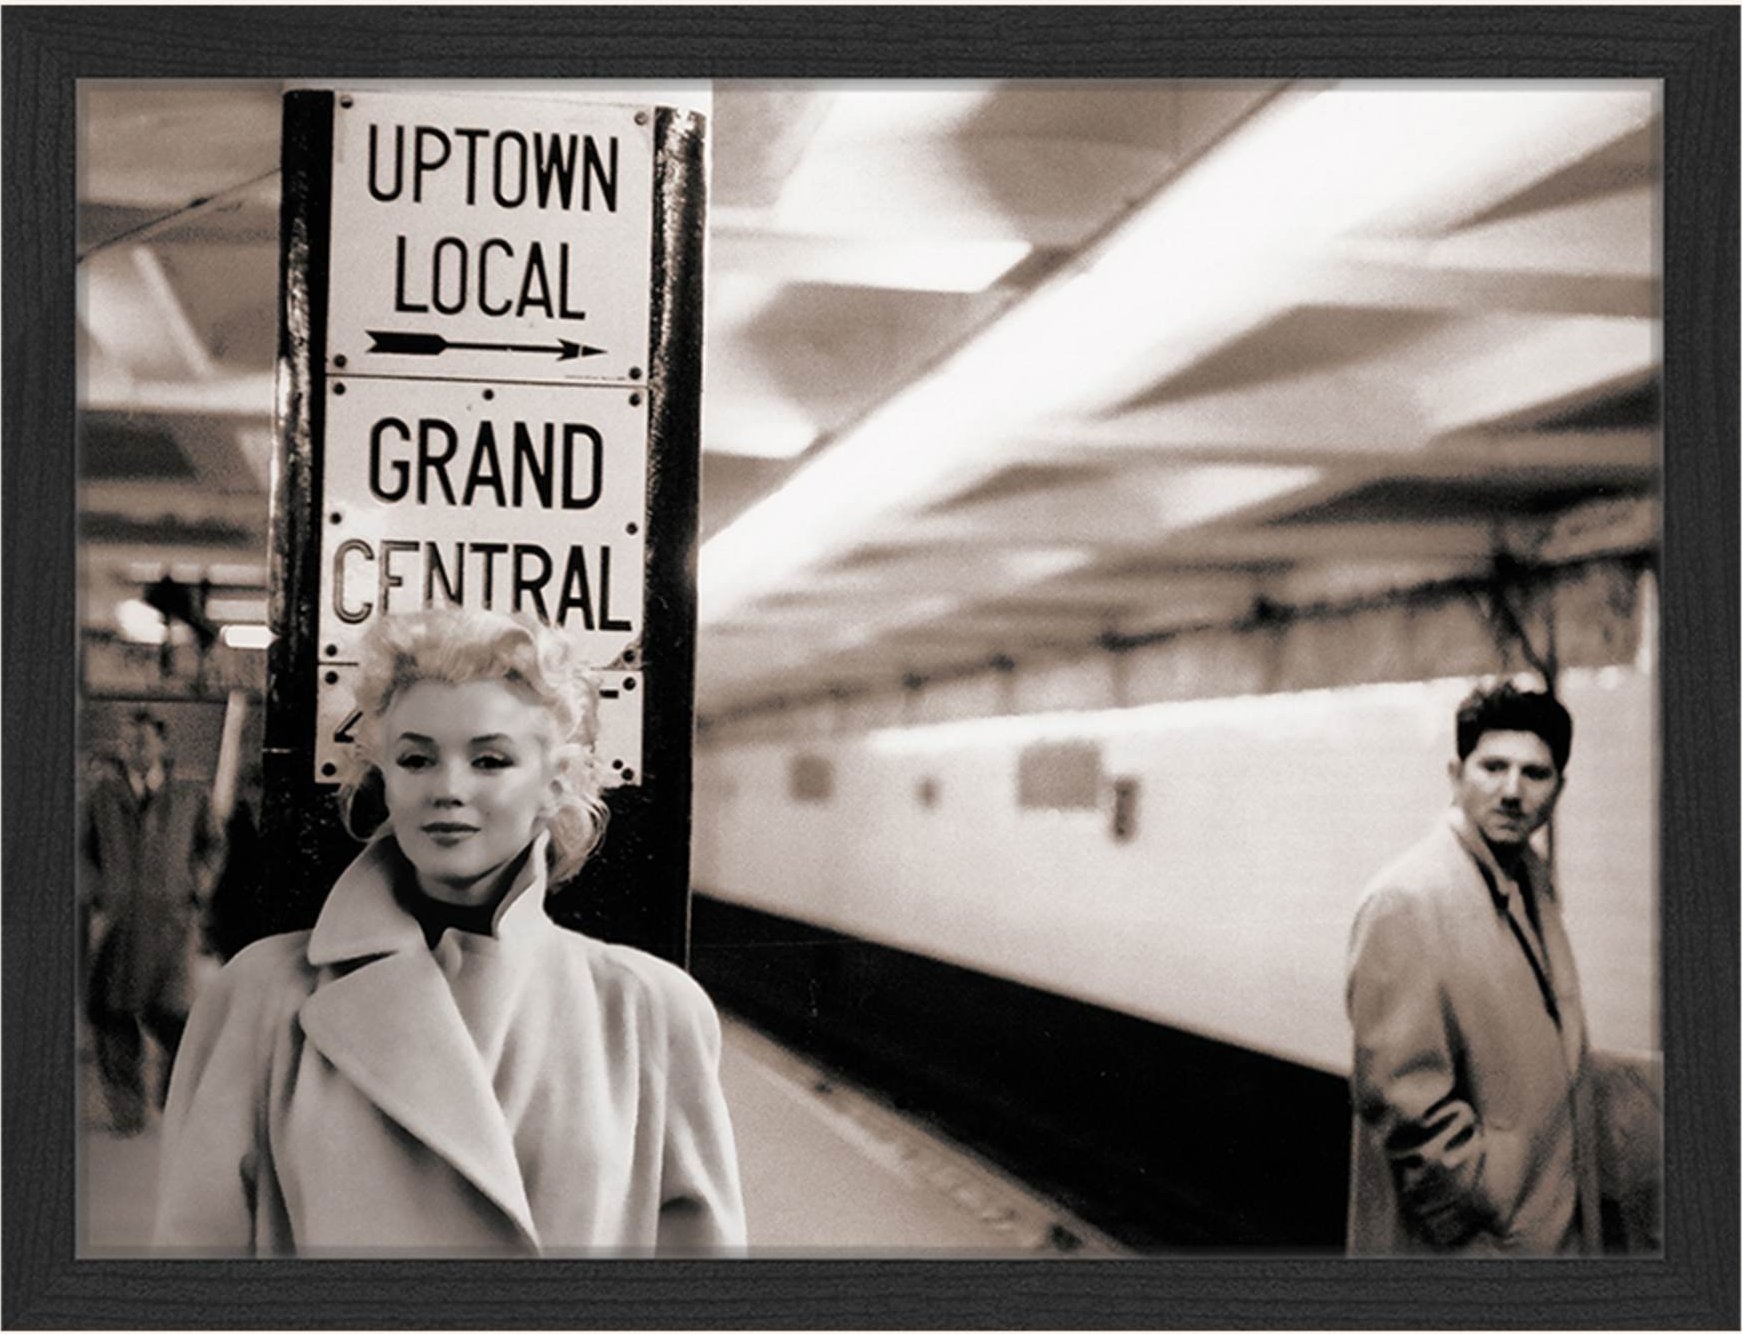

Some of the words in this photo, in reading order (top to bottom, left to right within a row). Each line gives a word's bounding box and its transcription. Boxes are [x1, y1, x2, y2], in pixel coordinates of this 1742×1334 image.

[368, 124, 618, 212] UPTOWN
[394, 235, 586, 320] LOCAL
[368, 416, 604, 510] GRAND
[332, 538, 633, 631] CENTRAL
